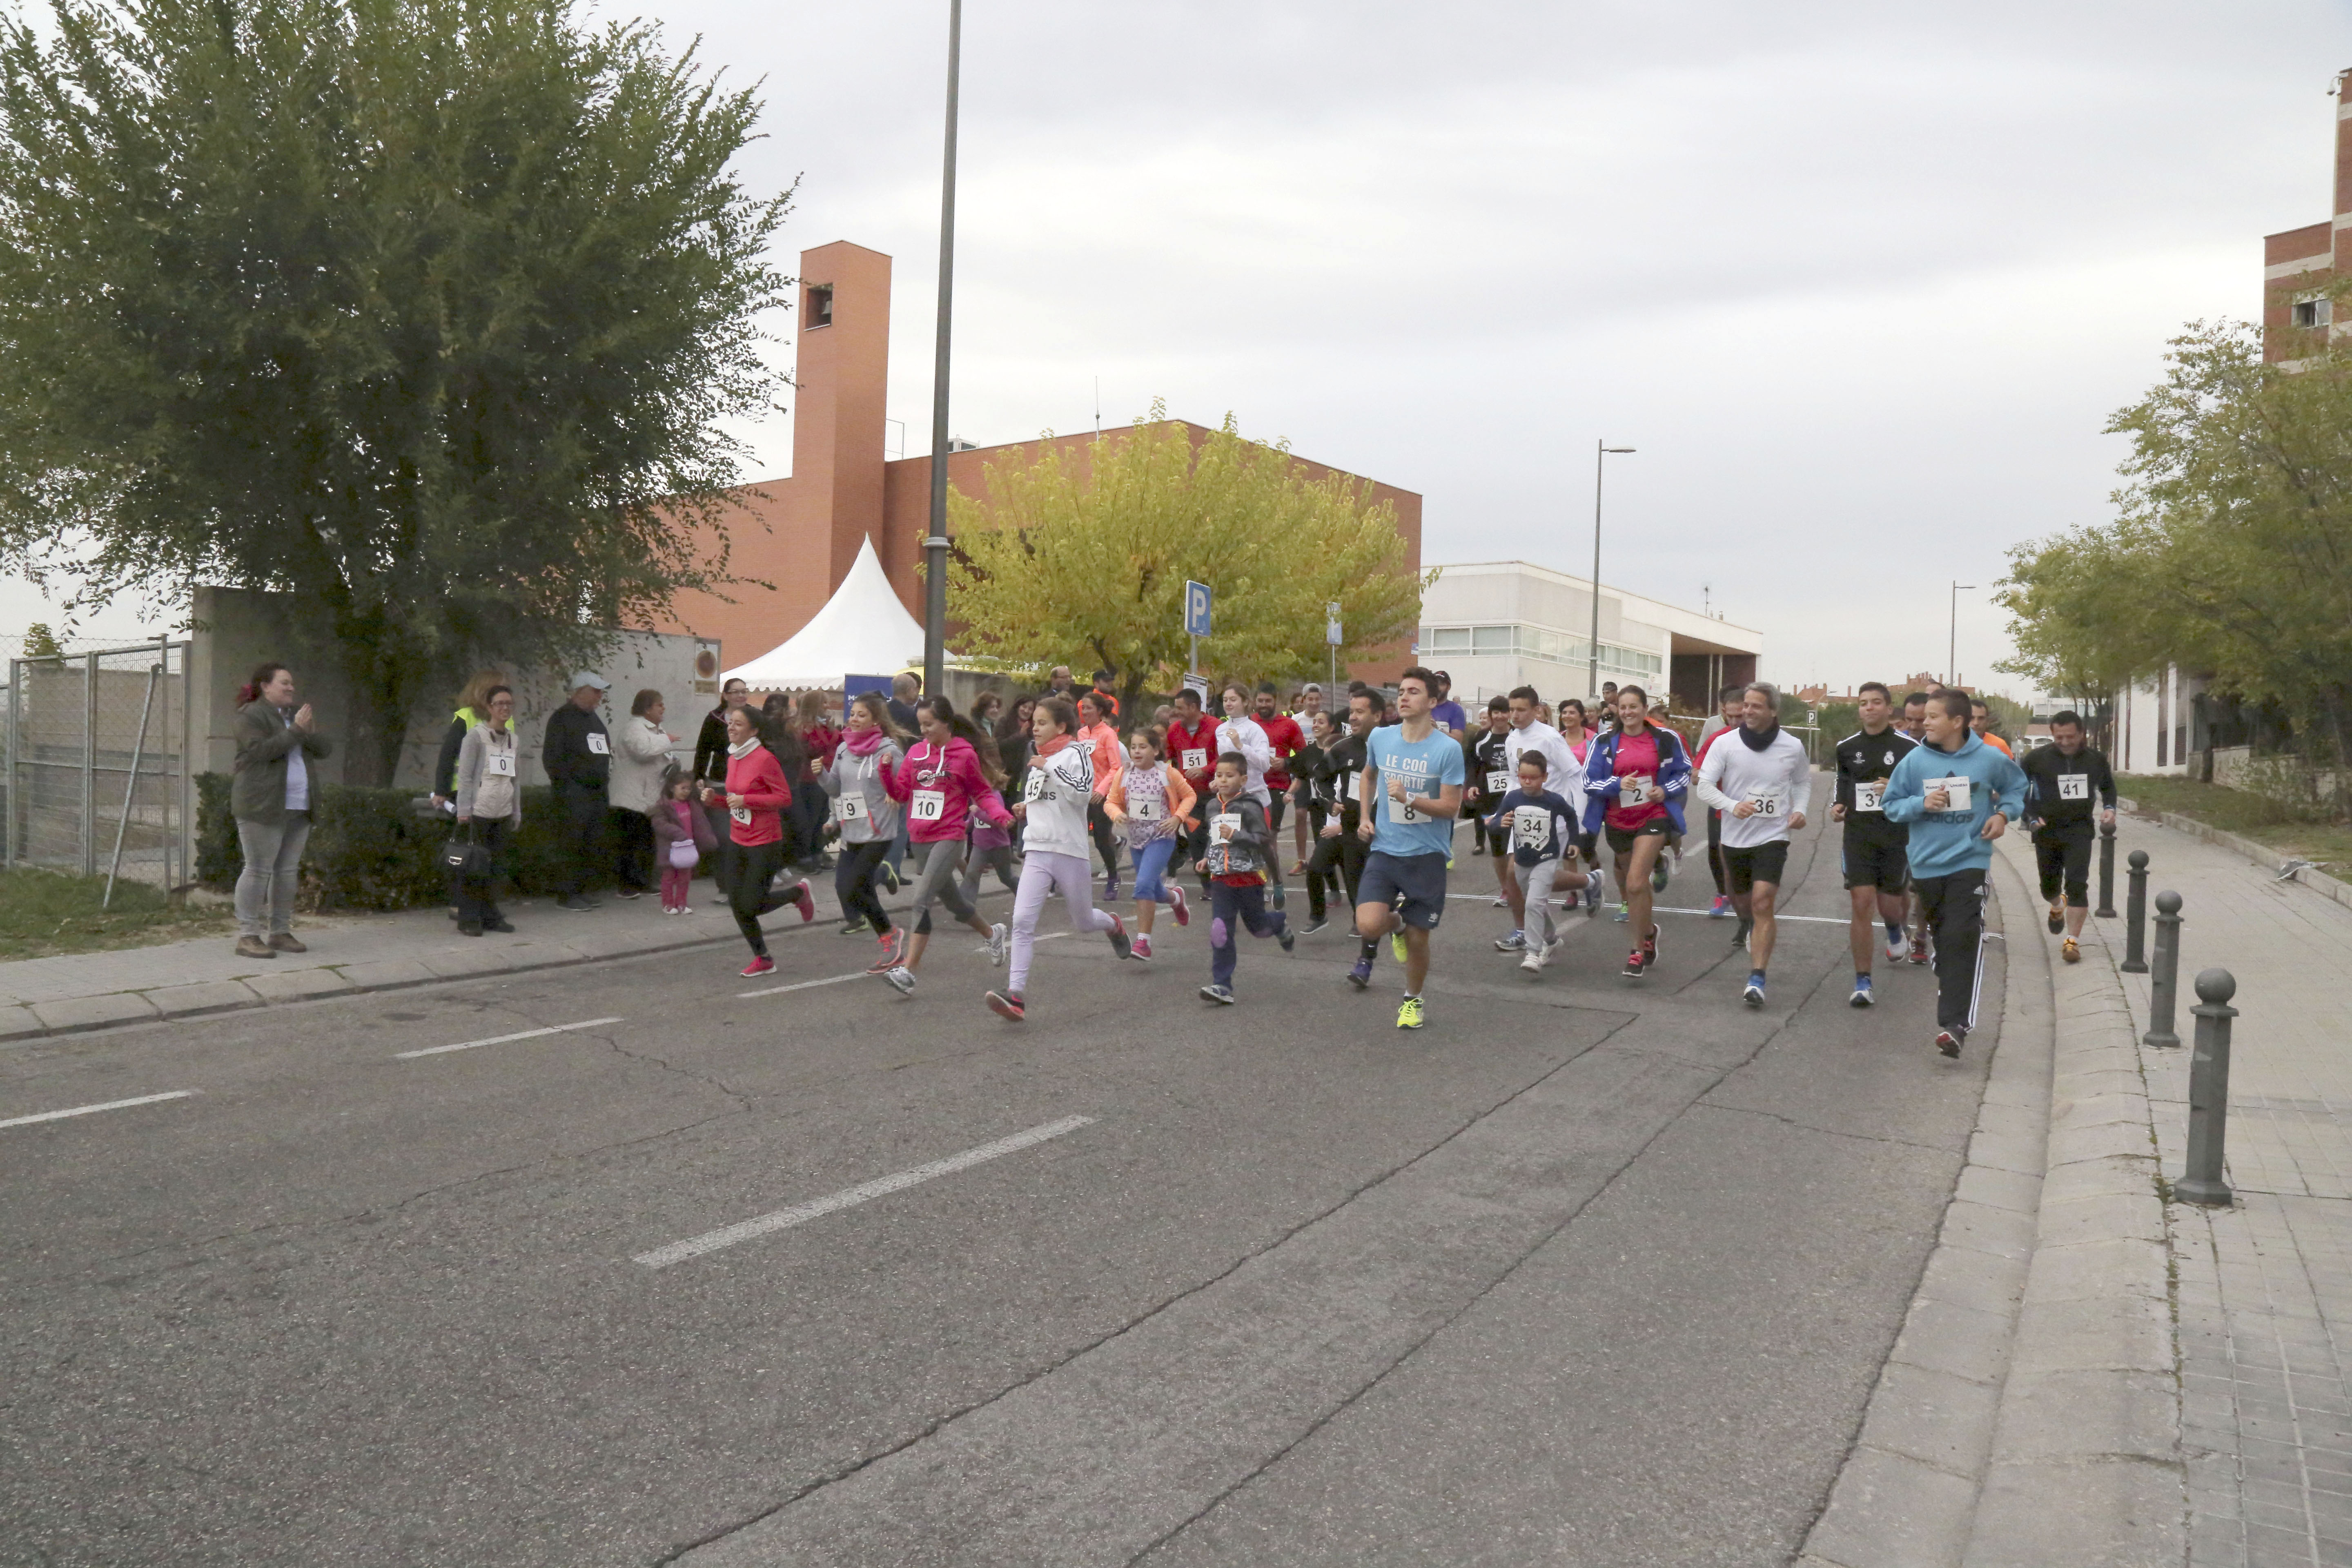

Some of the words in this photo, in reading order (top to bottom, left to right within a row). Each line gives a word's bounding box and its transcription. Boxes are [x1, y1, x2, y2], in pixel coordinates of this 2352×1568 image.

[1192, 588, 1206, 627] P
[1809, 712, 1814, 723] P
[597, 741, 601, 751] 0
[500, 759, 506, 771] 0
[1189, 756, 1200, 766] 51
[1385, 754, 1398, 768] LE
[1402, 757, 1428, 774] COQ
[1028, 781, 1039, 798] 45
[1494, 778, 1507, 789] 25
[2063, 784, 2078, 796] 41
[1633, 788, 1643, 802] 2
[847, 803, 855, 816] 9
[918, 801, 935, 816] 10
[1140, 804, 1149, 817] 4
[1404, 804, 1415, 820] 8
[1755, 799, 1774, 814] 36
[1523, 819, 1542, 833] 34
